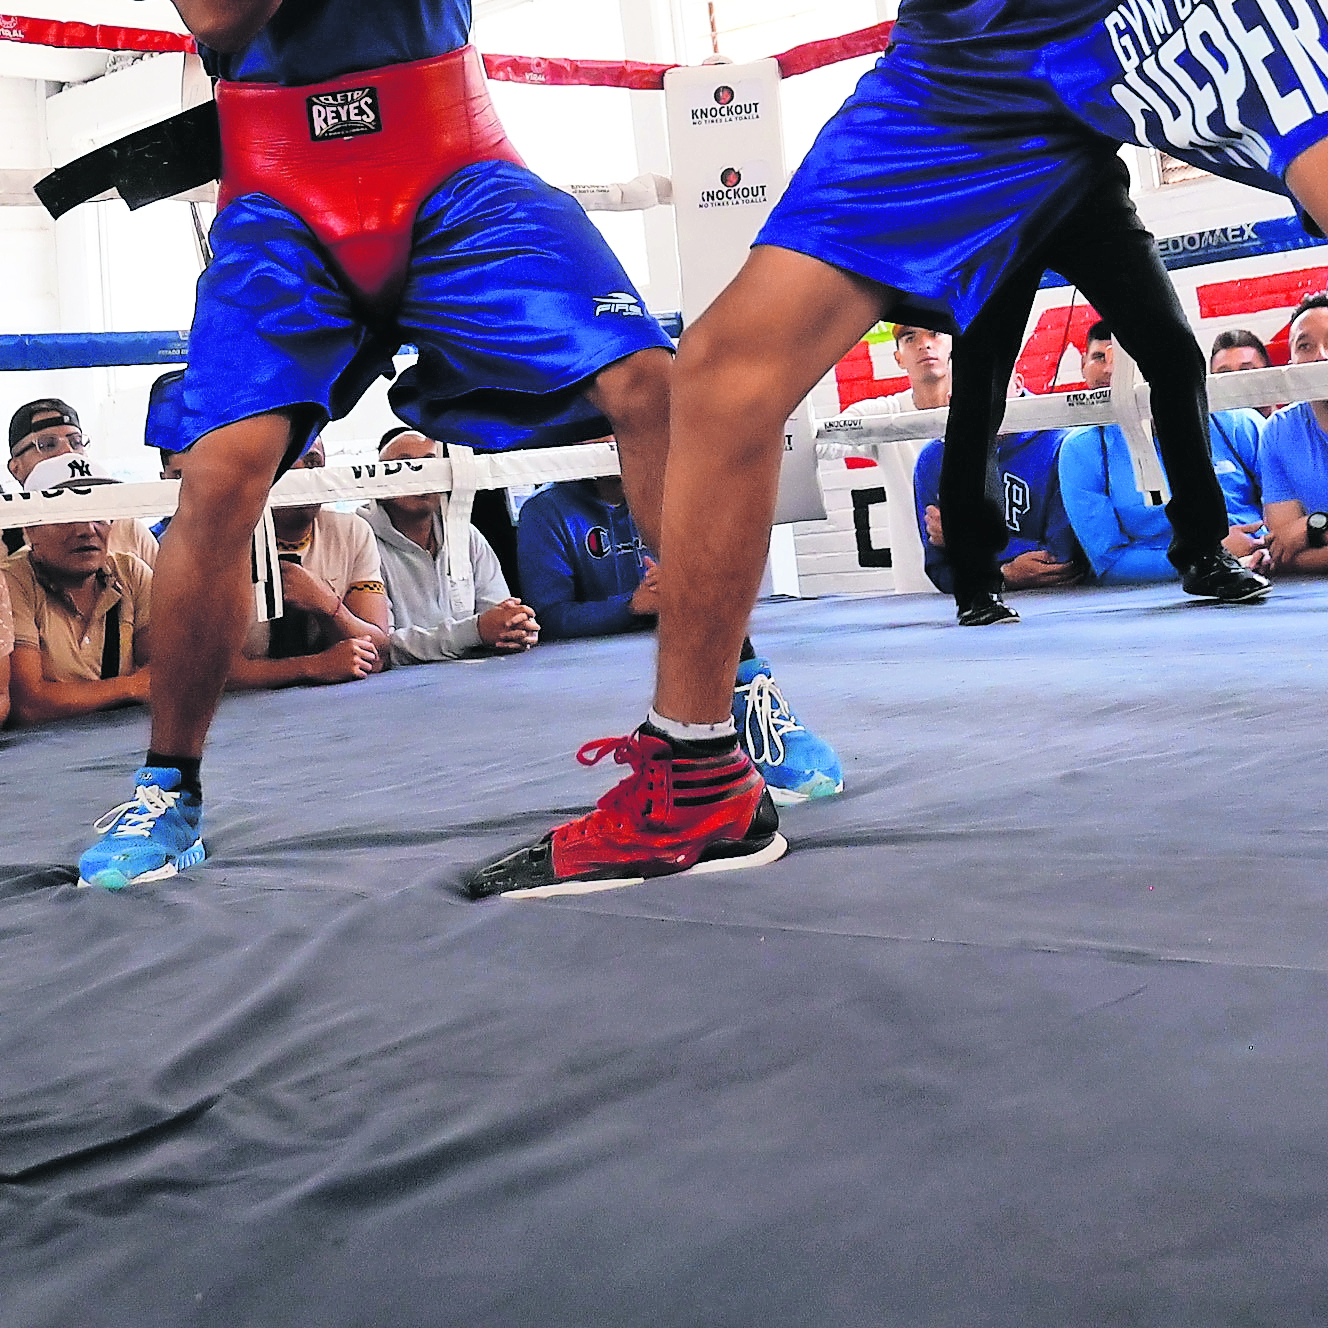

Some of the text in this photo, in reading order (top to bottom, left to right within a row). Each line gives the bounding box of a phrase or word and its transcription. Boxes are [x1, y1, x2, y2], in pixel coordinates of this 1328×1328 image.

[312, 97, 376, 137] REYES
[691, 102, 760, 120] KNOCKOUT
[1066, 389, 1111, 403] KNOKOUT
[824, 419, 863, 430] KNOCKOUT
[67, 459, 93, 479] NY
[1003, 471, 1031, 532] P
